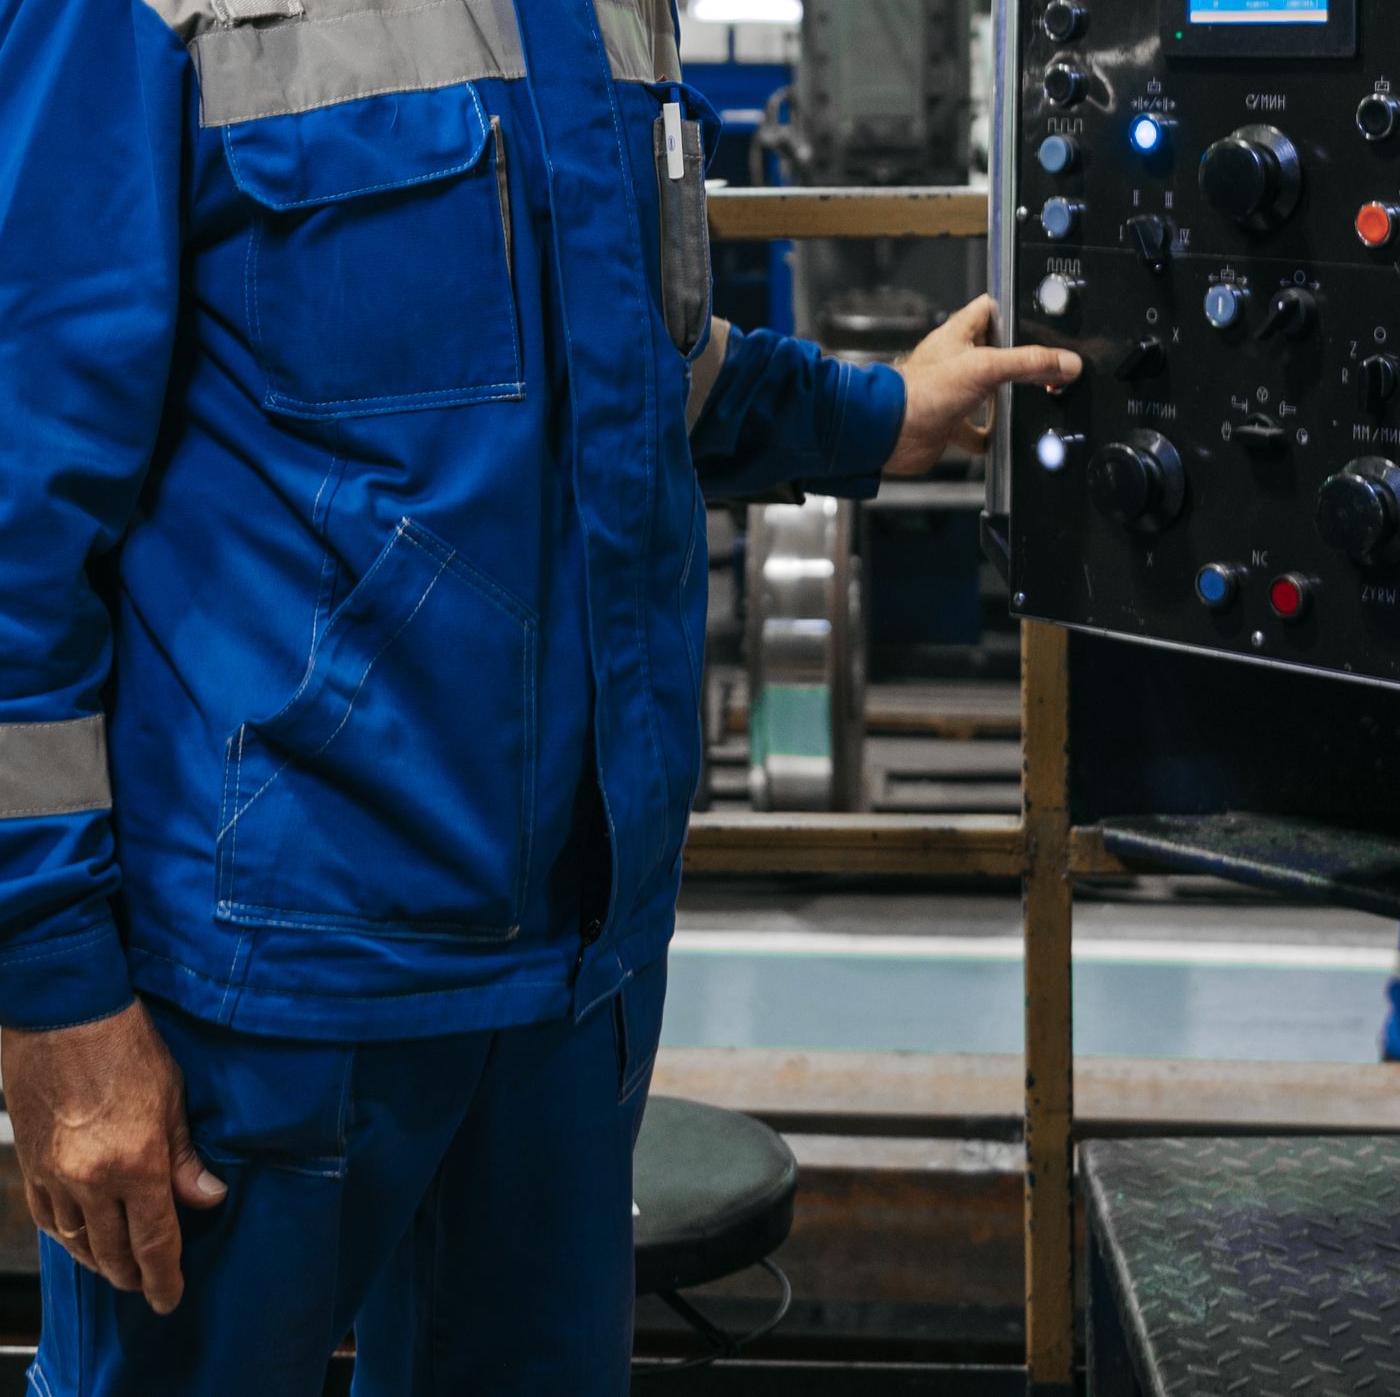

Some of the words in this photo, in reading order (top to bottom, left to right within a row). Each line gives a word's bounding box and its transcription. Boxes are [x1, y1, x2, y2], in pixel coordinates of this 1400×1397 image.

[1172, 326, 1180, 343] X
[1350, 340, 1357, 358] Z
[1341, 367, 1349, 384] R
[1252, 550, 1268, 567] NC
[1361, 586, 1396, 604] ZYRW
